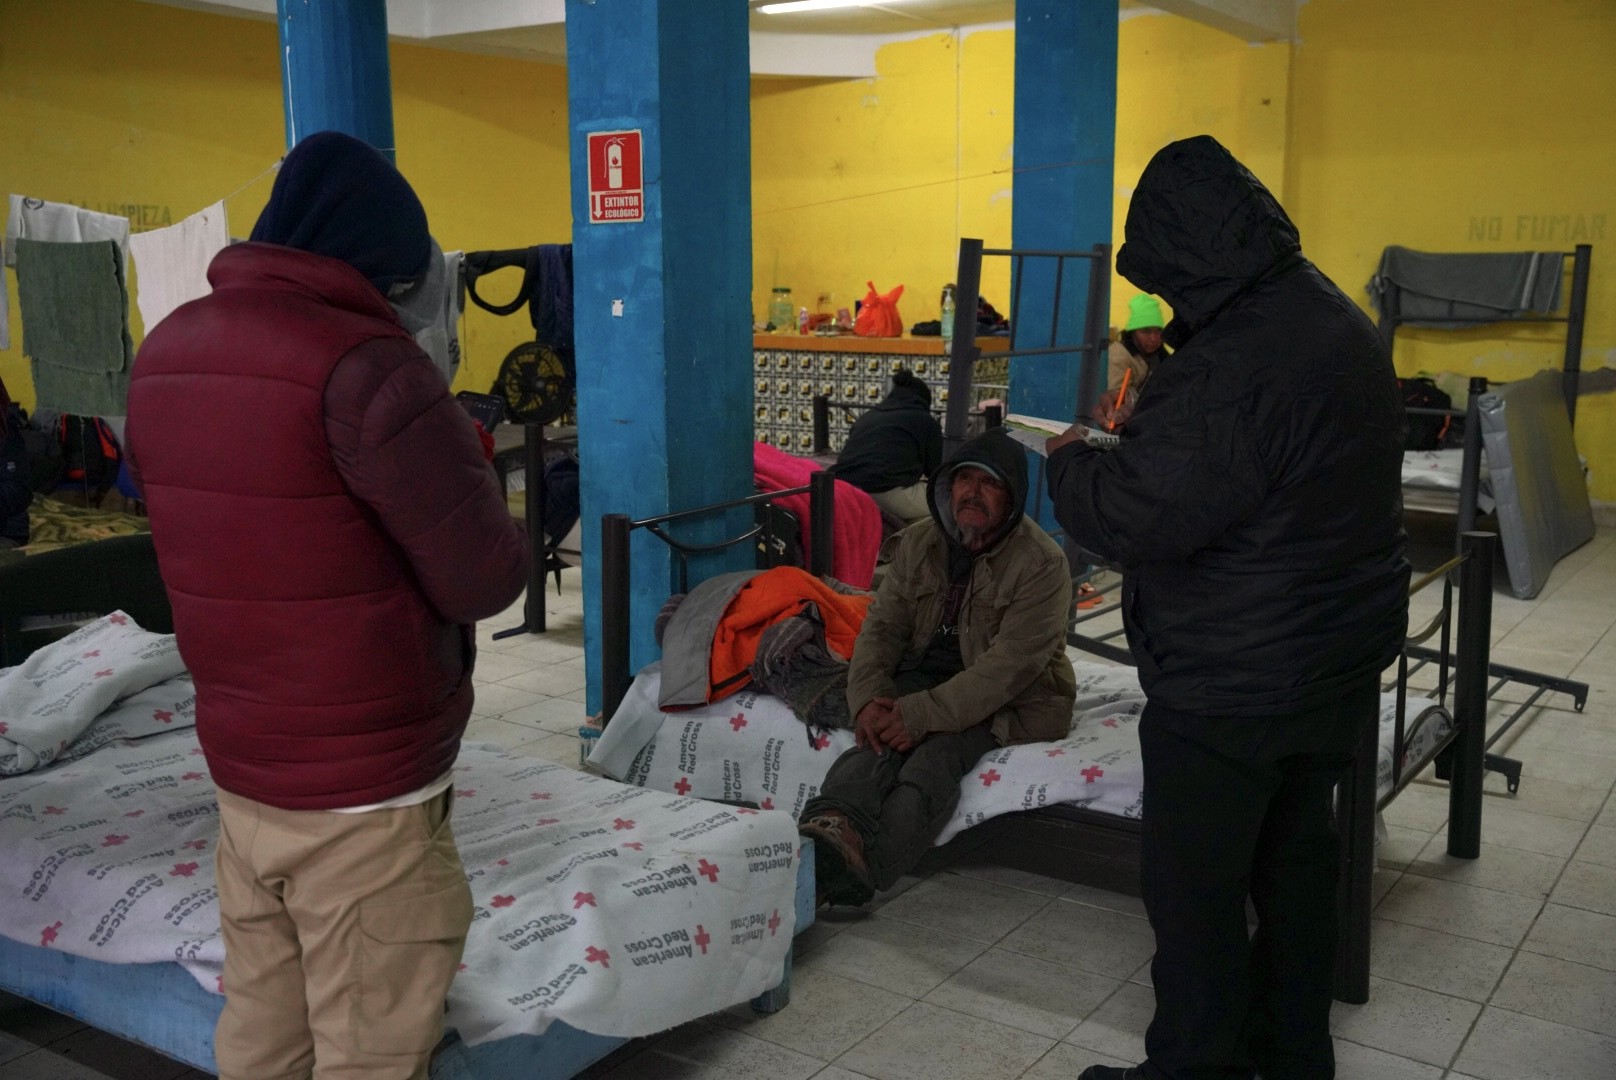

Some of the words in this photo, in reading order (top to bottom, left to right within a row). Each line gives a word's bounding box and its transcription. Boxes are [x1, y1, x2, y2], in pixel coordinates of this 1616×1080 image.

[604, 195, 639, 207] EXTINTOR
[604, 208, 639, 218] ECOLÓGICO
[1468, 215, 1503, 242] NO
[1516, 214, 1607, 242] FUMAR
[678, 720, 694, 772] American
[688, 722, 702, 757] Cross
[641, 744, 656, 774] Cross
[687, 757, 696, 774] Red
[762, 738, 775, 792] American
[772, 740, 784, 773] Cross
[637, 774, 647, 787] ed
[722, 759, 730, 800] merican
[733, 762, 741, 790] Cross
[770, 774, 780, 795] Red
[791, 782, 806, 822] erican
[167, 805, 210, 821] Cross
[705, 811, 732, 825] Red
[669, 821, 706, 838] Cross
[680, 815, 739, 840] American
[744, 846, 773, 858] Cross
[772, 842, 792, 856] Red
[666, 863, 692, 879] Red
[748, 855, 792, 873] American
[23, 855, 56, 897] Cross
[126, 873, 159, 897] Red
[621, 872, 665, 889] Cross
[632, 876, 698, 897] American
[97, 878, 164, 947] American
[163, 888, 211, 921] Cross
[88, 897, 127, 943] Cross
[540, 912, 571, 925] Red
[730, 915, 750, 930] Cross
[750, 911, 766, 925] Red
[498, 919, 542, 943] Cross
[510, 916, 578, 951] American
[662, 929, 690, 946] Red
[731, 928, 765, 945] American
[624, 937, 663, 953] Cross
[631, 944, 693, 967] American
[549, 963, 579, 988] Red
[507, 986, 551, 1006] Cross
